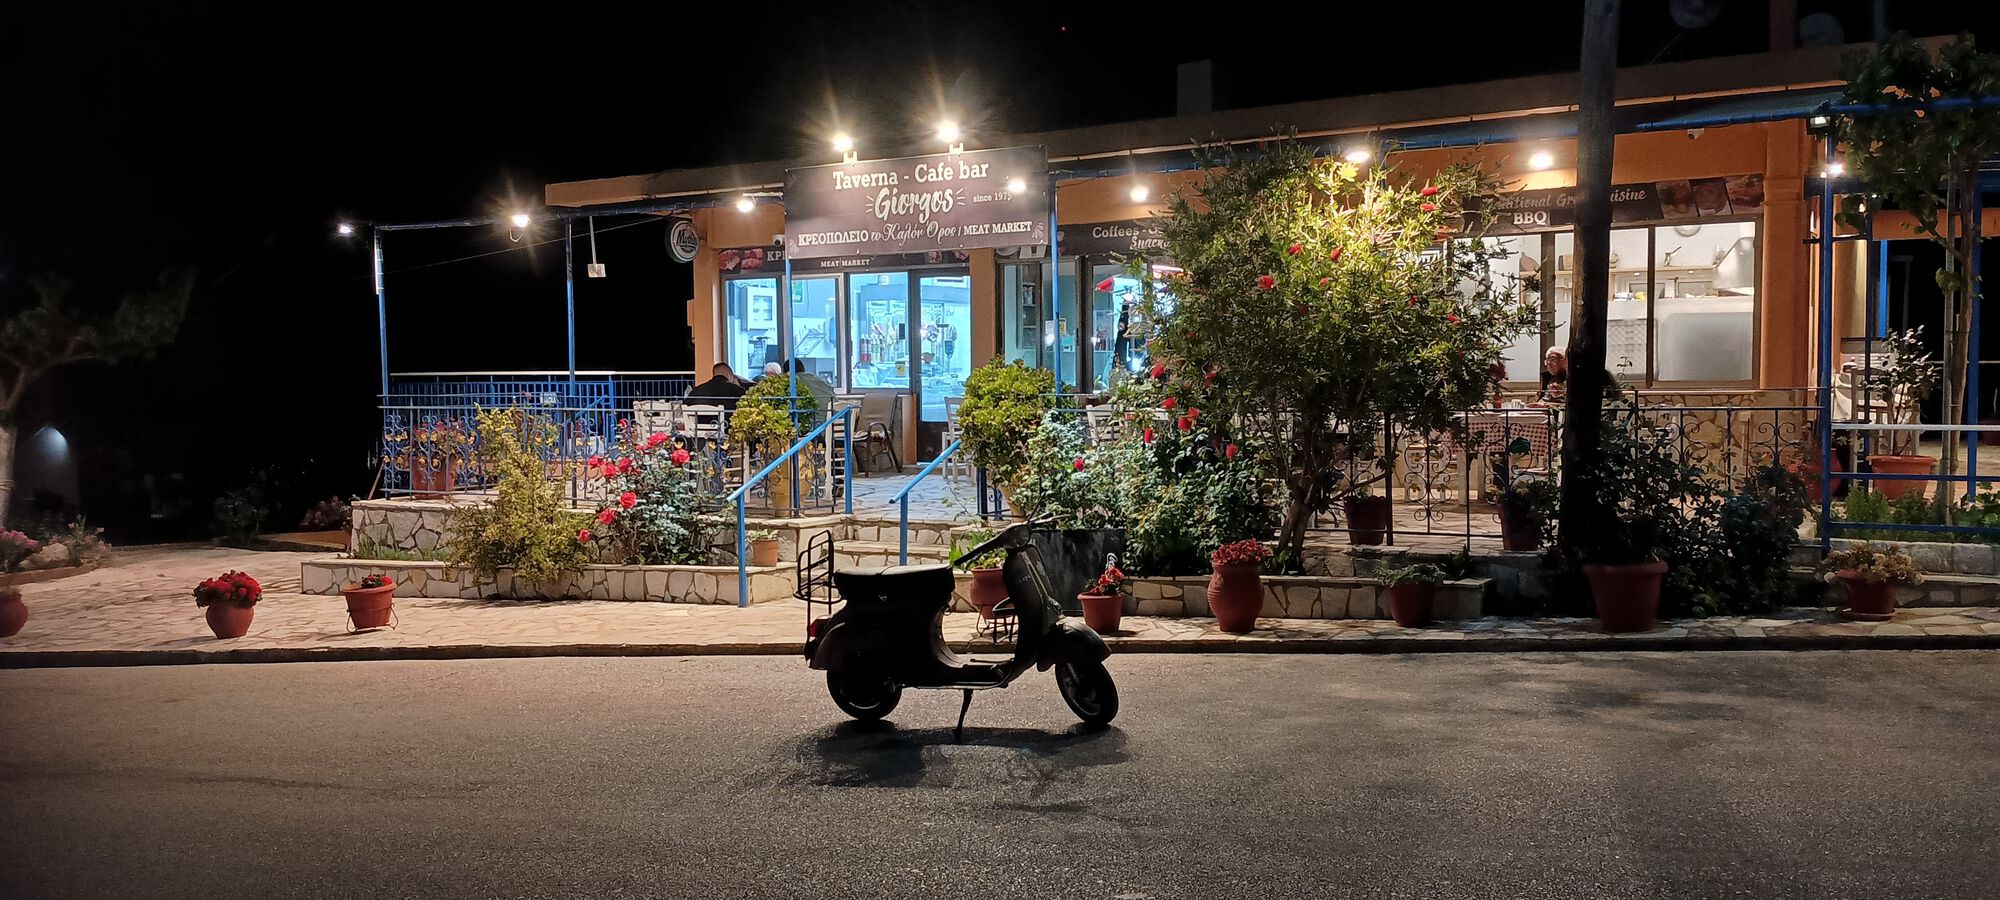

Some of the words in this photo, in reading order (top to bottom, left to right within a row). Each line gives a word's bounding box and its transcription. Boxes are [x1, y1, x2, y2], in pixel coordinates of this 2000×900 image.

[833, 170, 898, 190] Taverna
[914, 161, 954, 183] Cafe
[958, 159, 989, 180] bar
[973, 193, 992, 203] since
[1609, 188, 1648, 203] uisine
[874, 186, 954, 224] Giorgos
[1513, 211, 1548, 226] BBQ
[797, 229, 869, 247] ΚΡΕΟΠΩΛΕΙΟ
[963, 224, 990, 235] MEAT
[992, 220, 1032, 234] MARKET
[1092, 226, 1140, 239] Coffees
[820, 260, 839, 268] MEAT
[841, 258, 870, 267] MARKET
